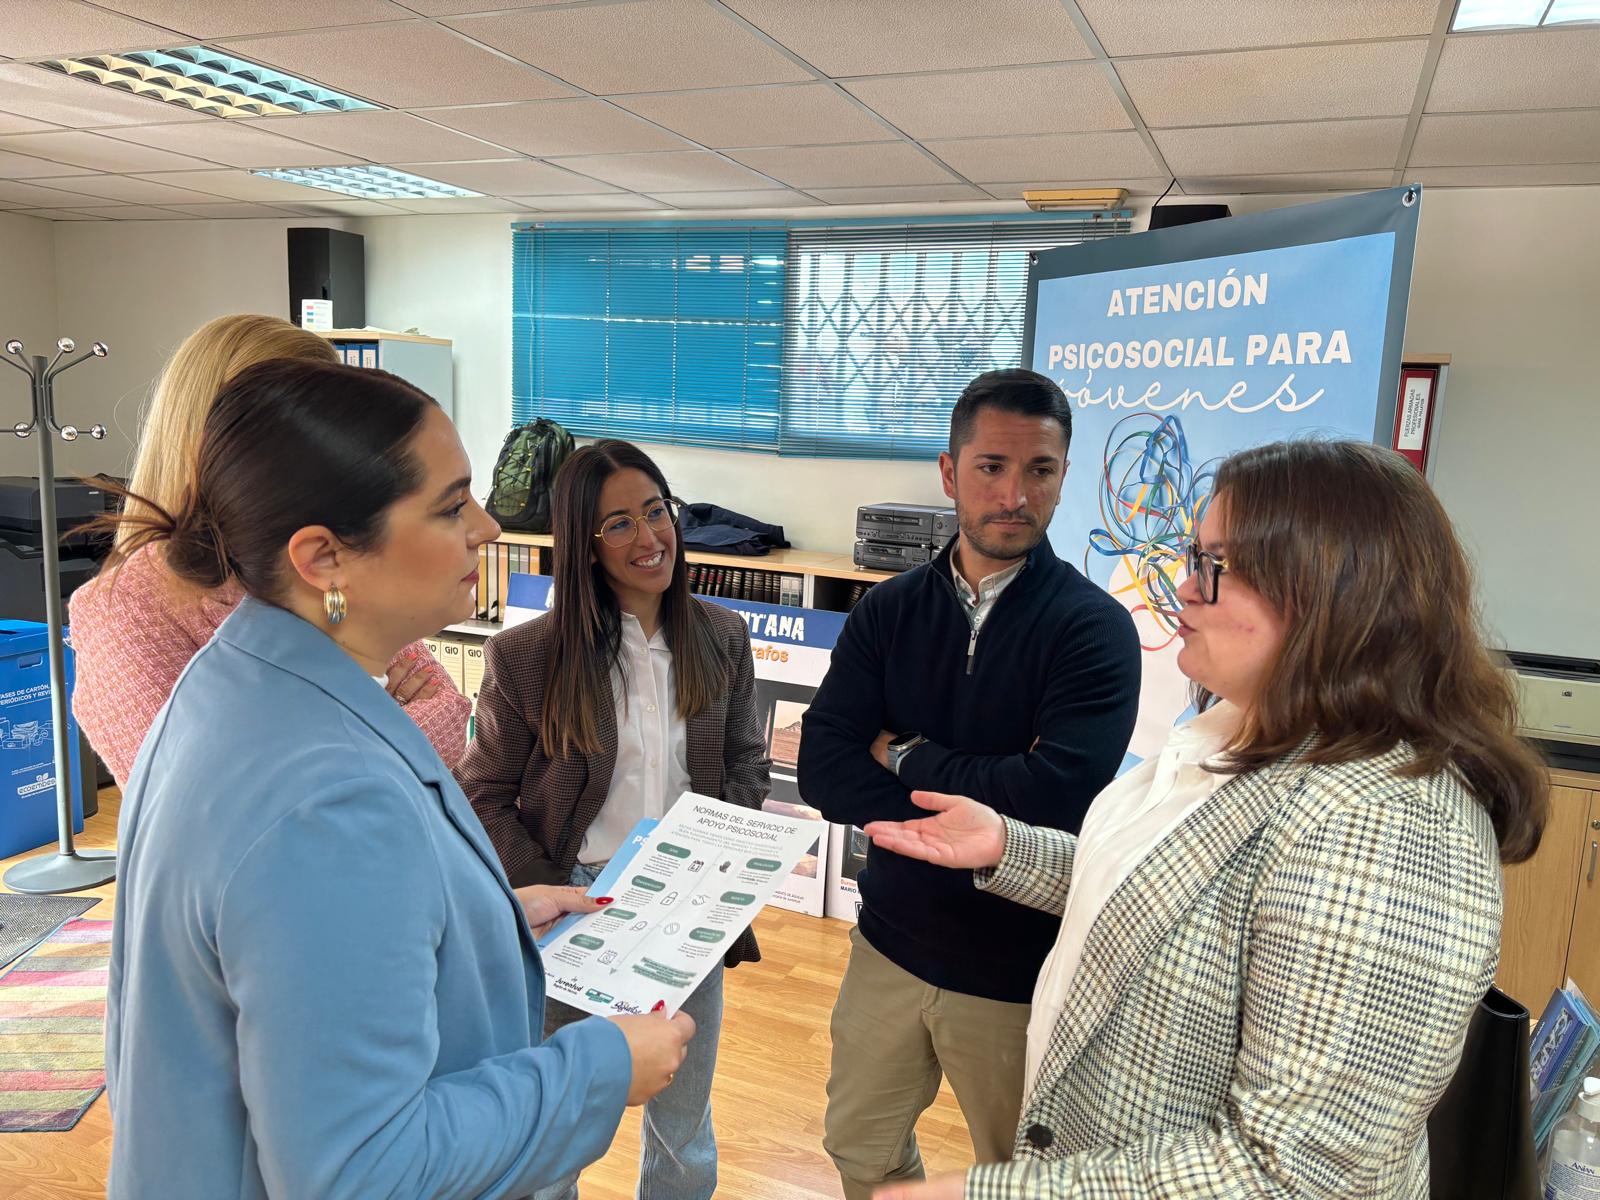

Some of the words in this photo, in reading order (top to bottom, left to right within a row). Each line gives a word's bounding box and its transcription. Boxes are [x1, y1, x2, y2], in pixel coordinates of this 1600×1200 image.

[1107, 268, 1269, 317] ATENCIÓN
[1048, 336, 1235, 370] PSICOSOCIAL
[1245, 330, 1352, 366] PARA
[1058, 369, 1325, 414] óvenes
[732, 610, 805, 641] NTANA
[445, 646, 459, 655] GIO
[468, 649, 482, 658] GIO
[0, 691, 16, 700] ASES
[693, 805, 729, 820] NORMAS
[729, 815, 745, 825] DEL
[746, 819, 784, 833] SERVICIO
[784, 827, 798, 835] DE
[697, 817, 726, 830] APOYO
[726, 824, 778, 841] PSICOSOCIAL
